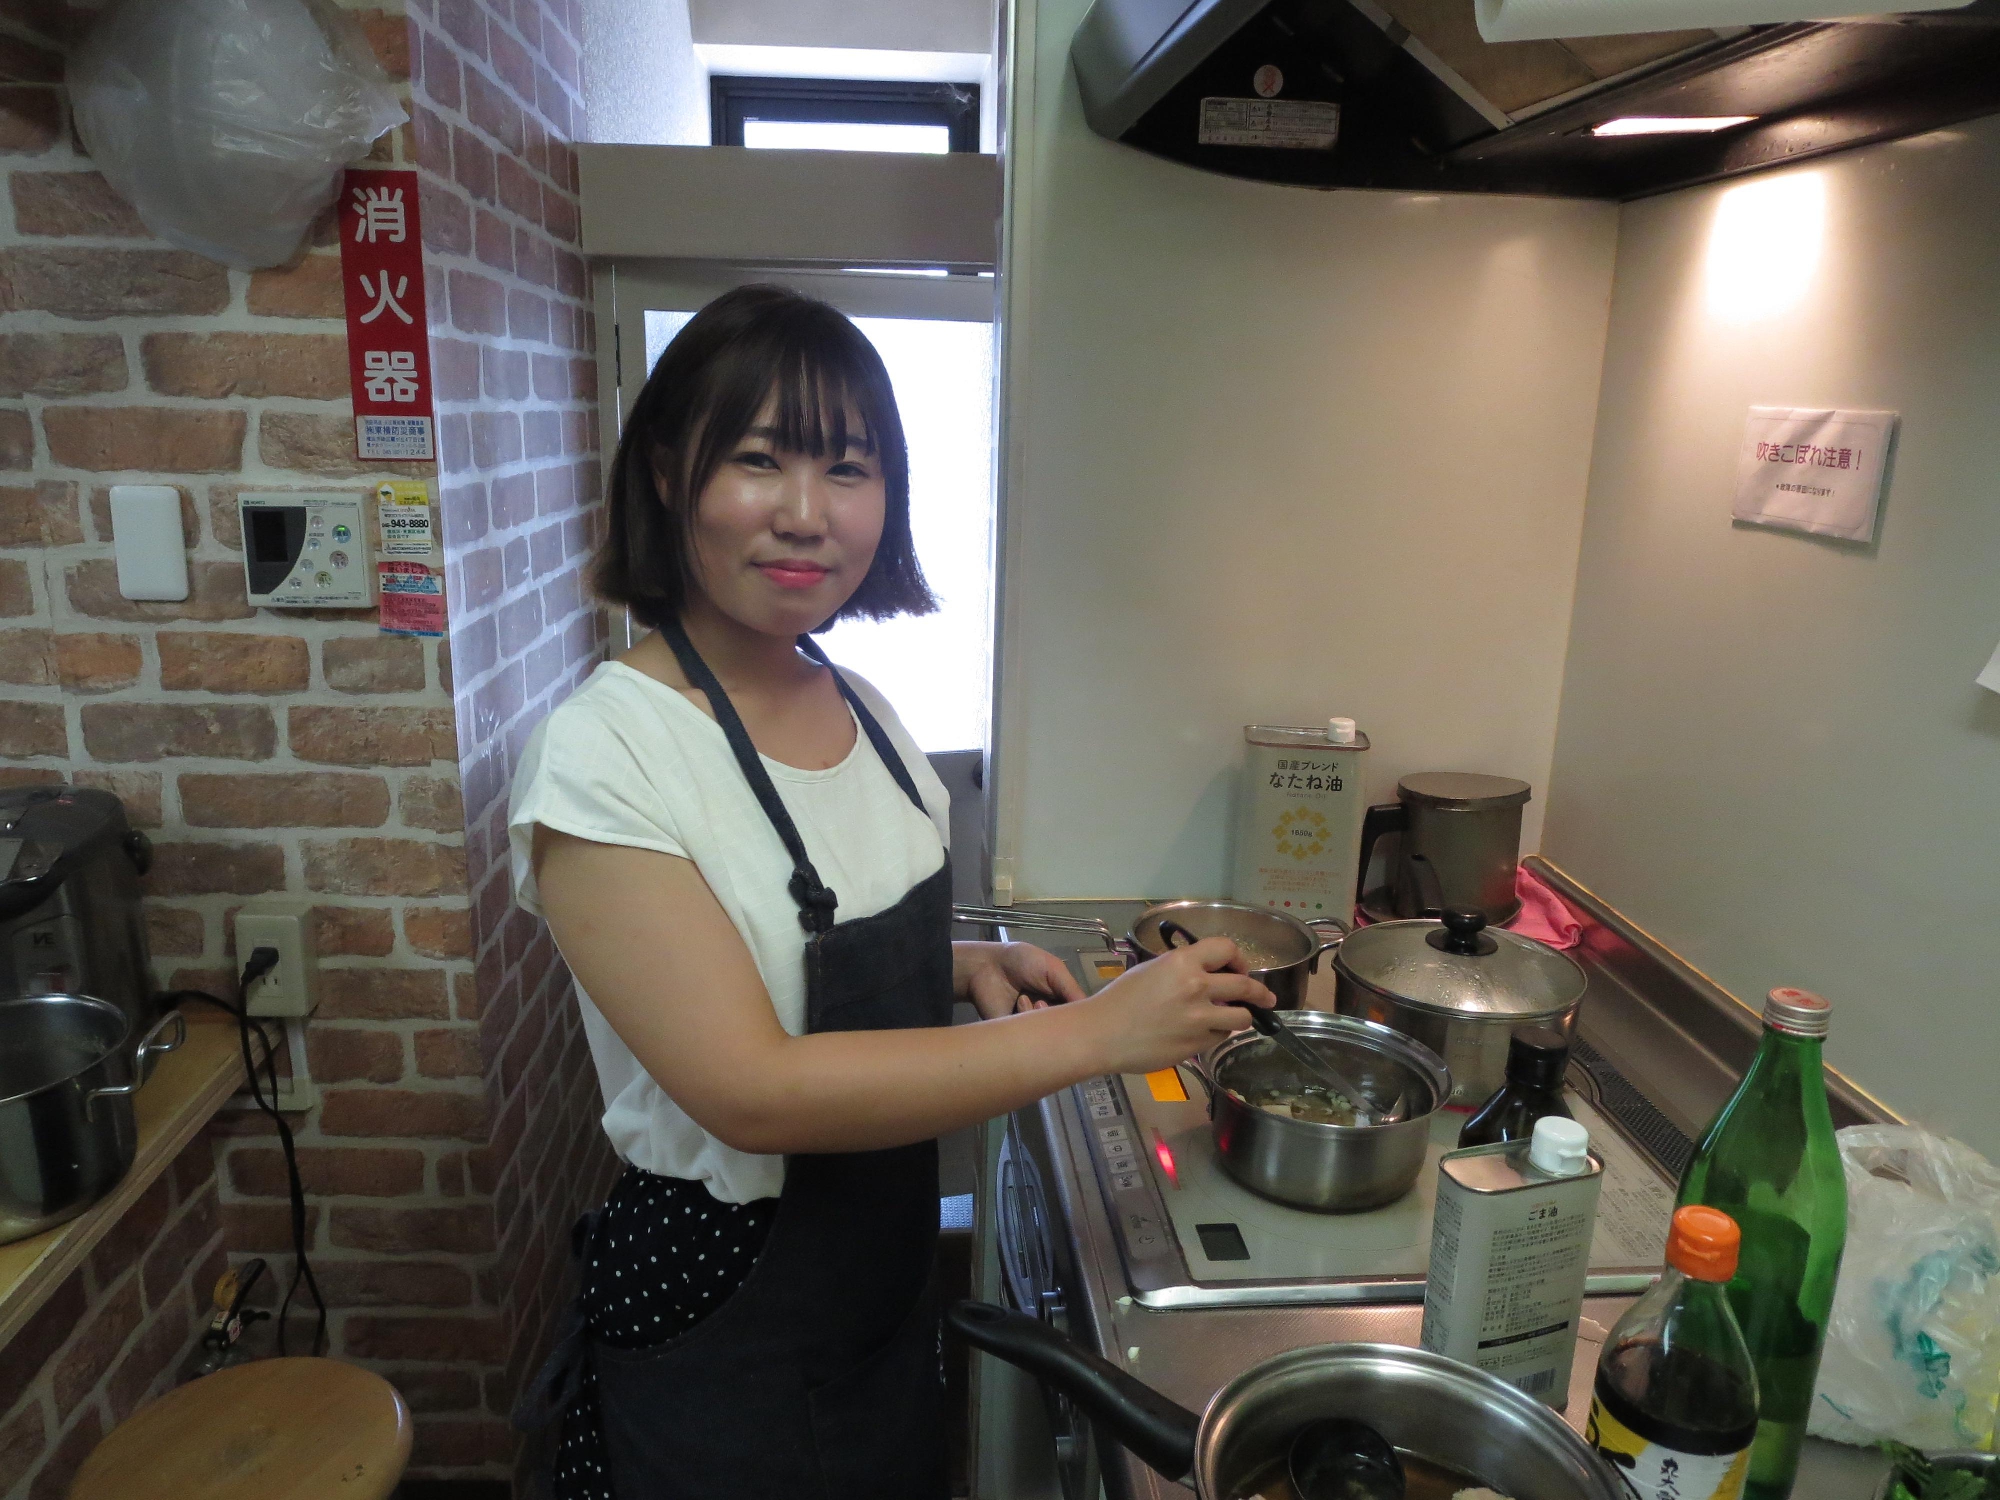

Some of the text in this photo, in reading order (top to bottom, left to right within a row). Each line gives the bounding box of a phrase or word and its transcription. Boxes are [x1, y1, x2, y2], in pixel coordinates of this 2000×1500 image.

[352, 187, 418, 402] 消火器
[1756, 442, 1862, 470] 吹きこぼれ注意！
[1278, 760, 1339, 772] 国産ブレンド
[1269, 772, 1343, 792] なたね油
